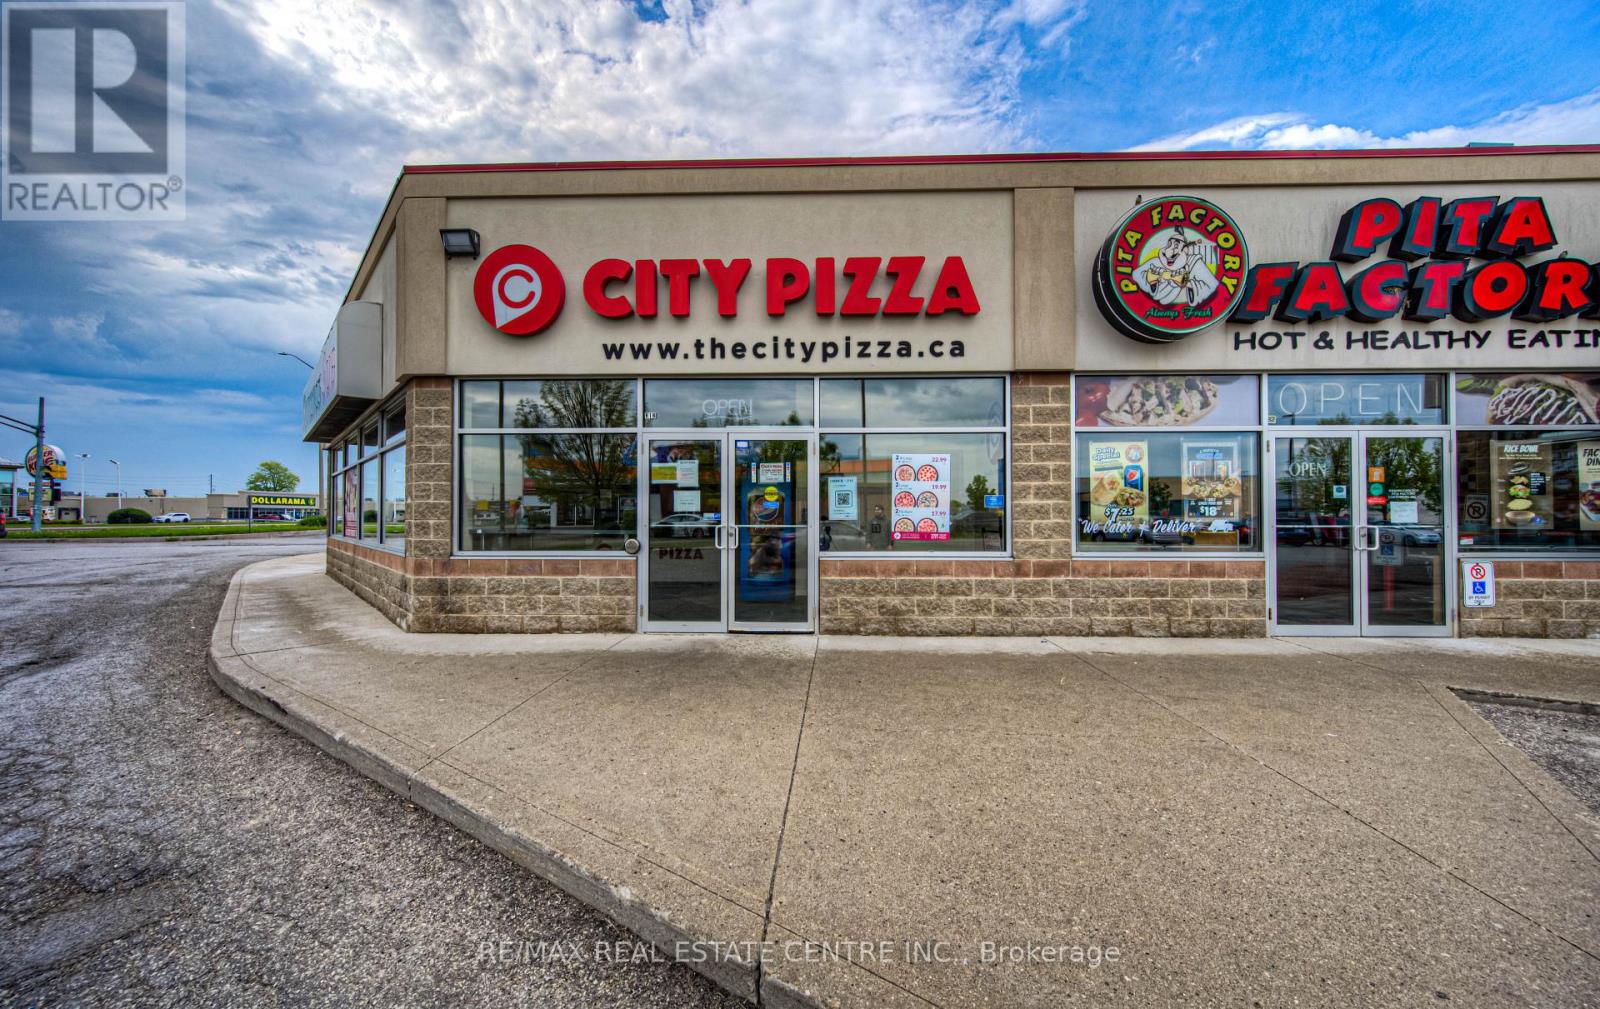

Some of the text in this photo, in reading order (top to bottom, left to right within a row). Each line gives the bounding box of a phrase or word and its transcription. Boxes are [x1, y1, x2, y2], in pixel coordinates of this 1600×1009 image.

[1335, 196, 1558, 260] PITA
[1115, 203, 1242, 297] PITA FACTORY
[583, 256, 981, 318] CITY PIZZA
[1229, 258, 1600, 323] FACTOR
[1182, 306, 1212, 319] Fresh
[602, 336, 965, 363] www.thecitypizza.ca
[1234, 331, 1306, 350] HOT
[1313, 330, 1335, 350] &
[1346, 330, 1492, 350] HEALTHY
[702, 398, 753, 416] OPEN
[1279, 382, 1422, 415] OPEN
[1503, 444, 1520, 453] RICE
[1289, 462, 1326, 477] OPEN
[251, 496, 306, 505] DOLLARAMA
[658, 548, 704, 560] PIZZA
